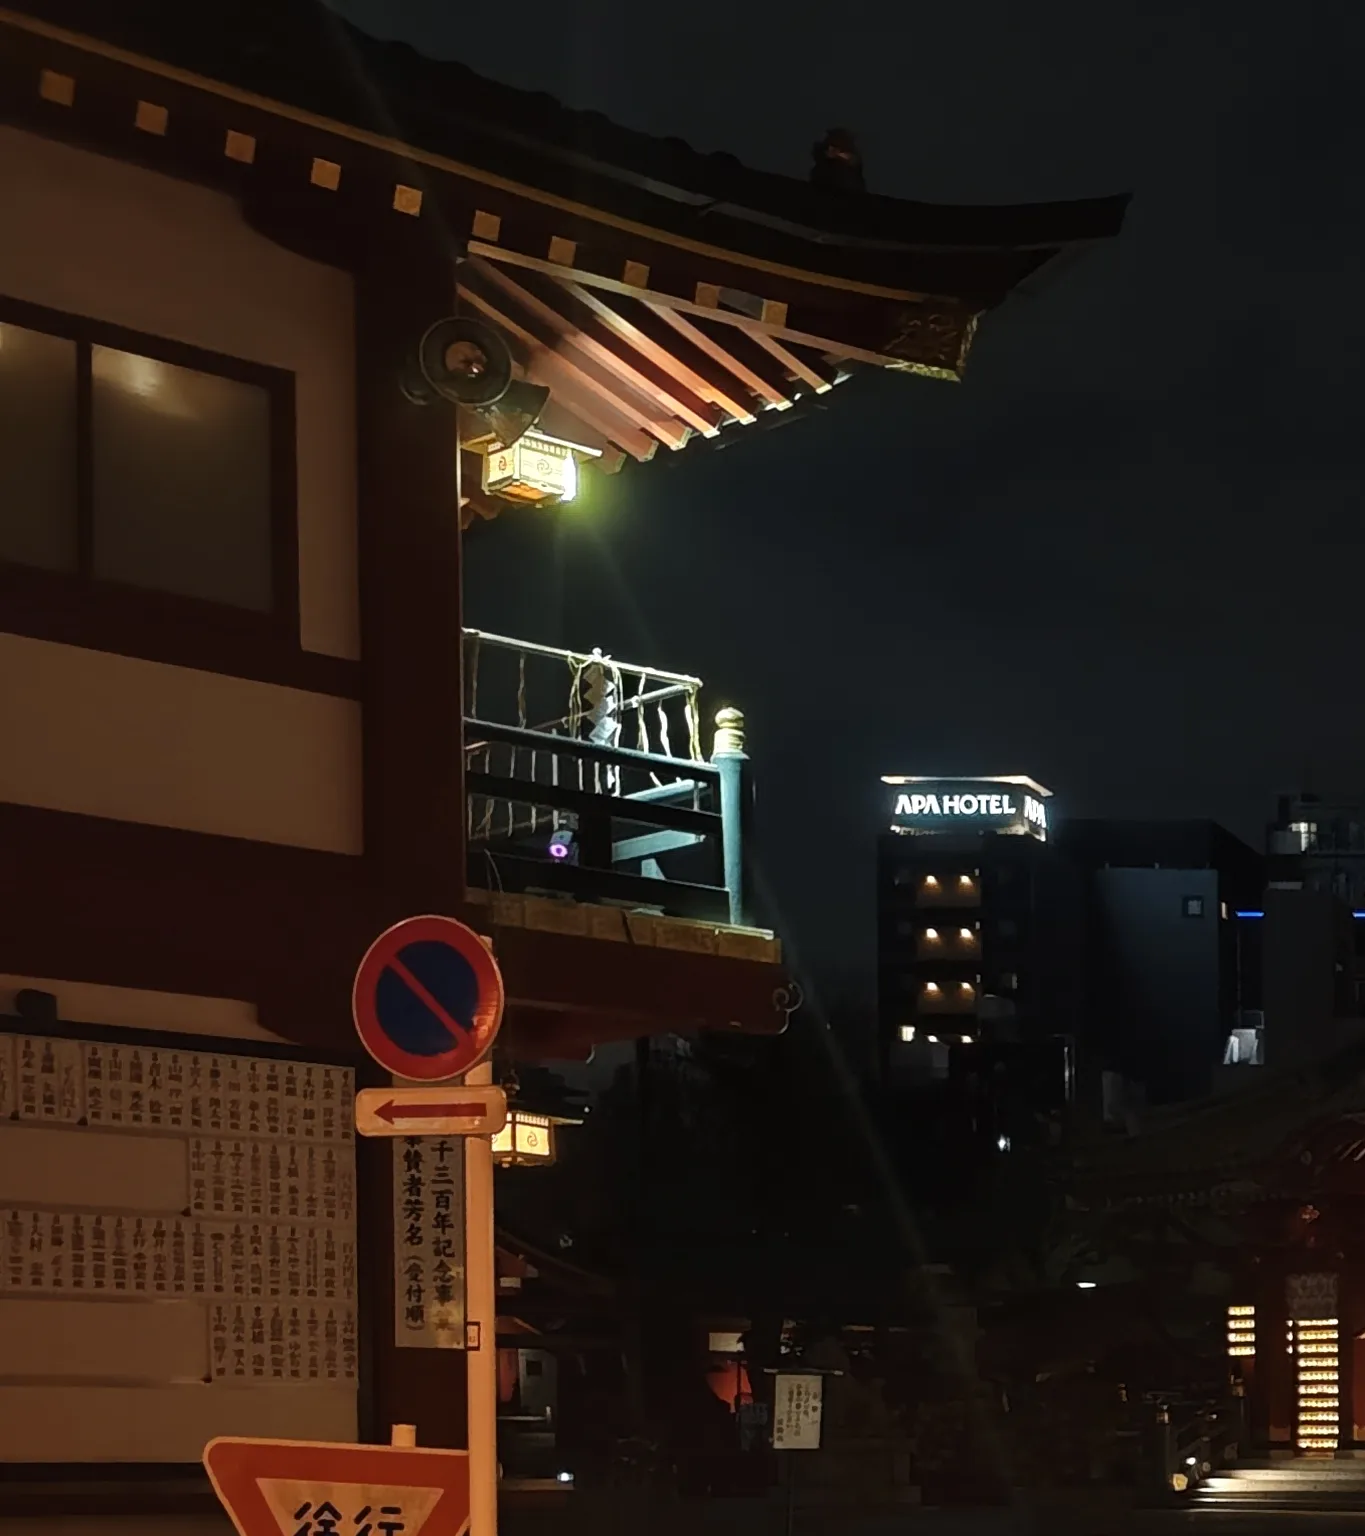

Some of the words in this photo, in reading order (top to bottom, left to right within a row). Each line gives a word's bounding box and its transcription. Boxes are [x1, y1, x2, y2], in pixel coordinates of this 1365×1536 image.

[895, 794, 941, 815] APA
[943, 794, 1016, 815] HOTEL
[1023, 796, 1047, 828] APA
